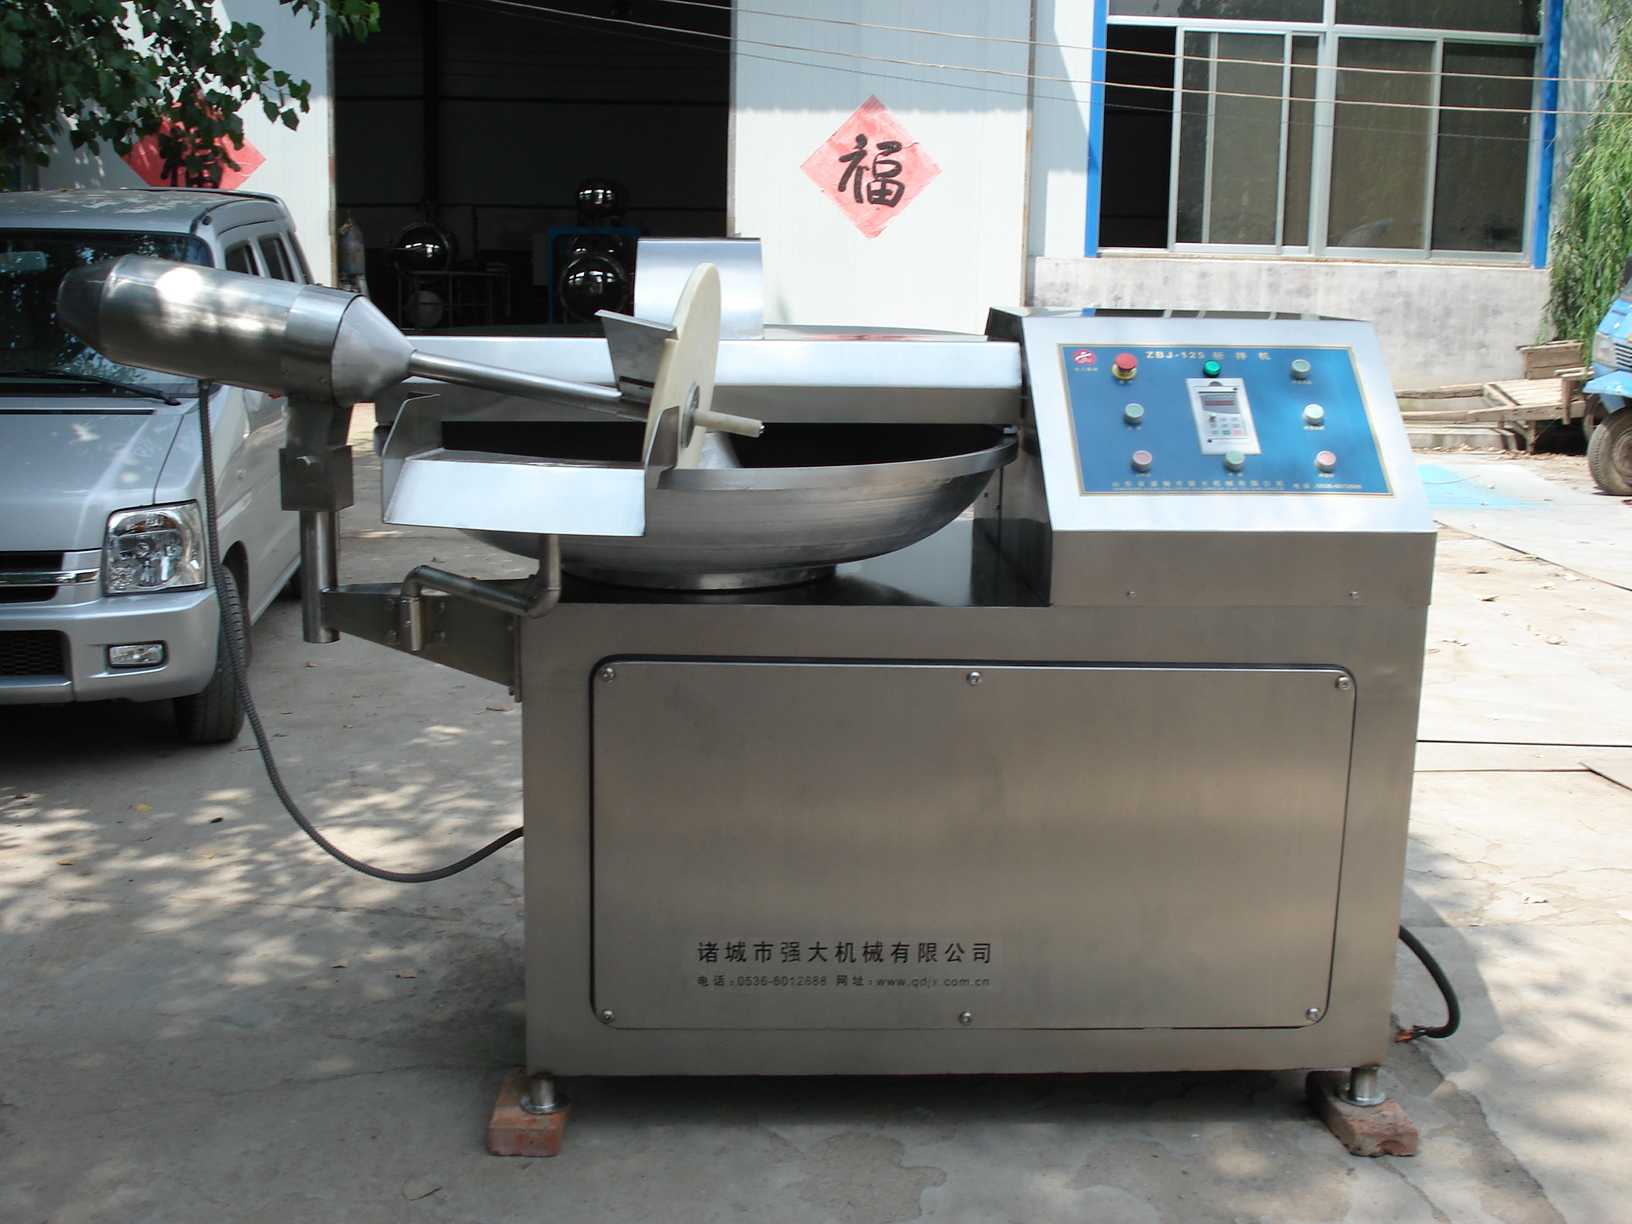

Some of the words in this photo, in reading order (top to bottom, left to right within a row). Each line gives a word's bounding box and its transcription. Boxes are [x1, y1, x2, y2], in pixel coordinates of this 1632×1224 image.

[838, 133, 905, 208] 福
[1145, 350, 1206, 360] ZBJ-125
[698, 941, 991, 964] 诸城市强大机械有限公司
